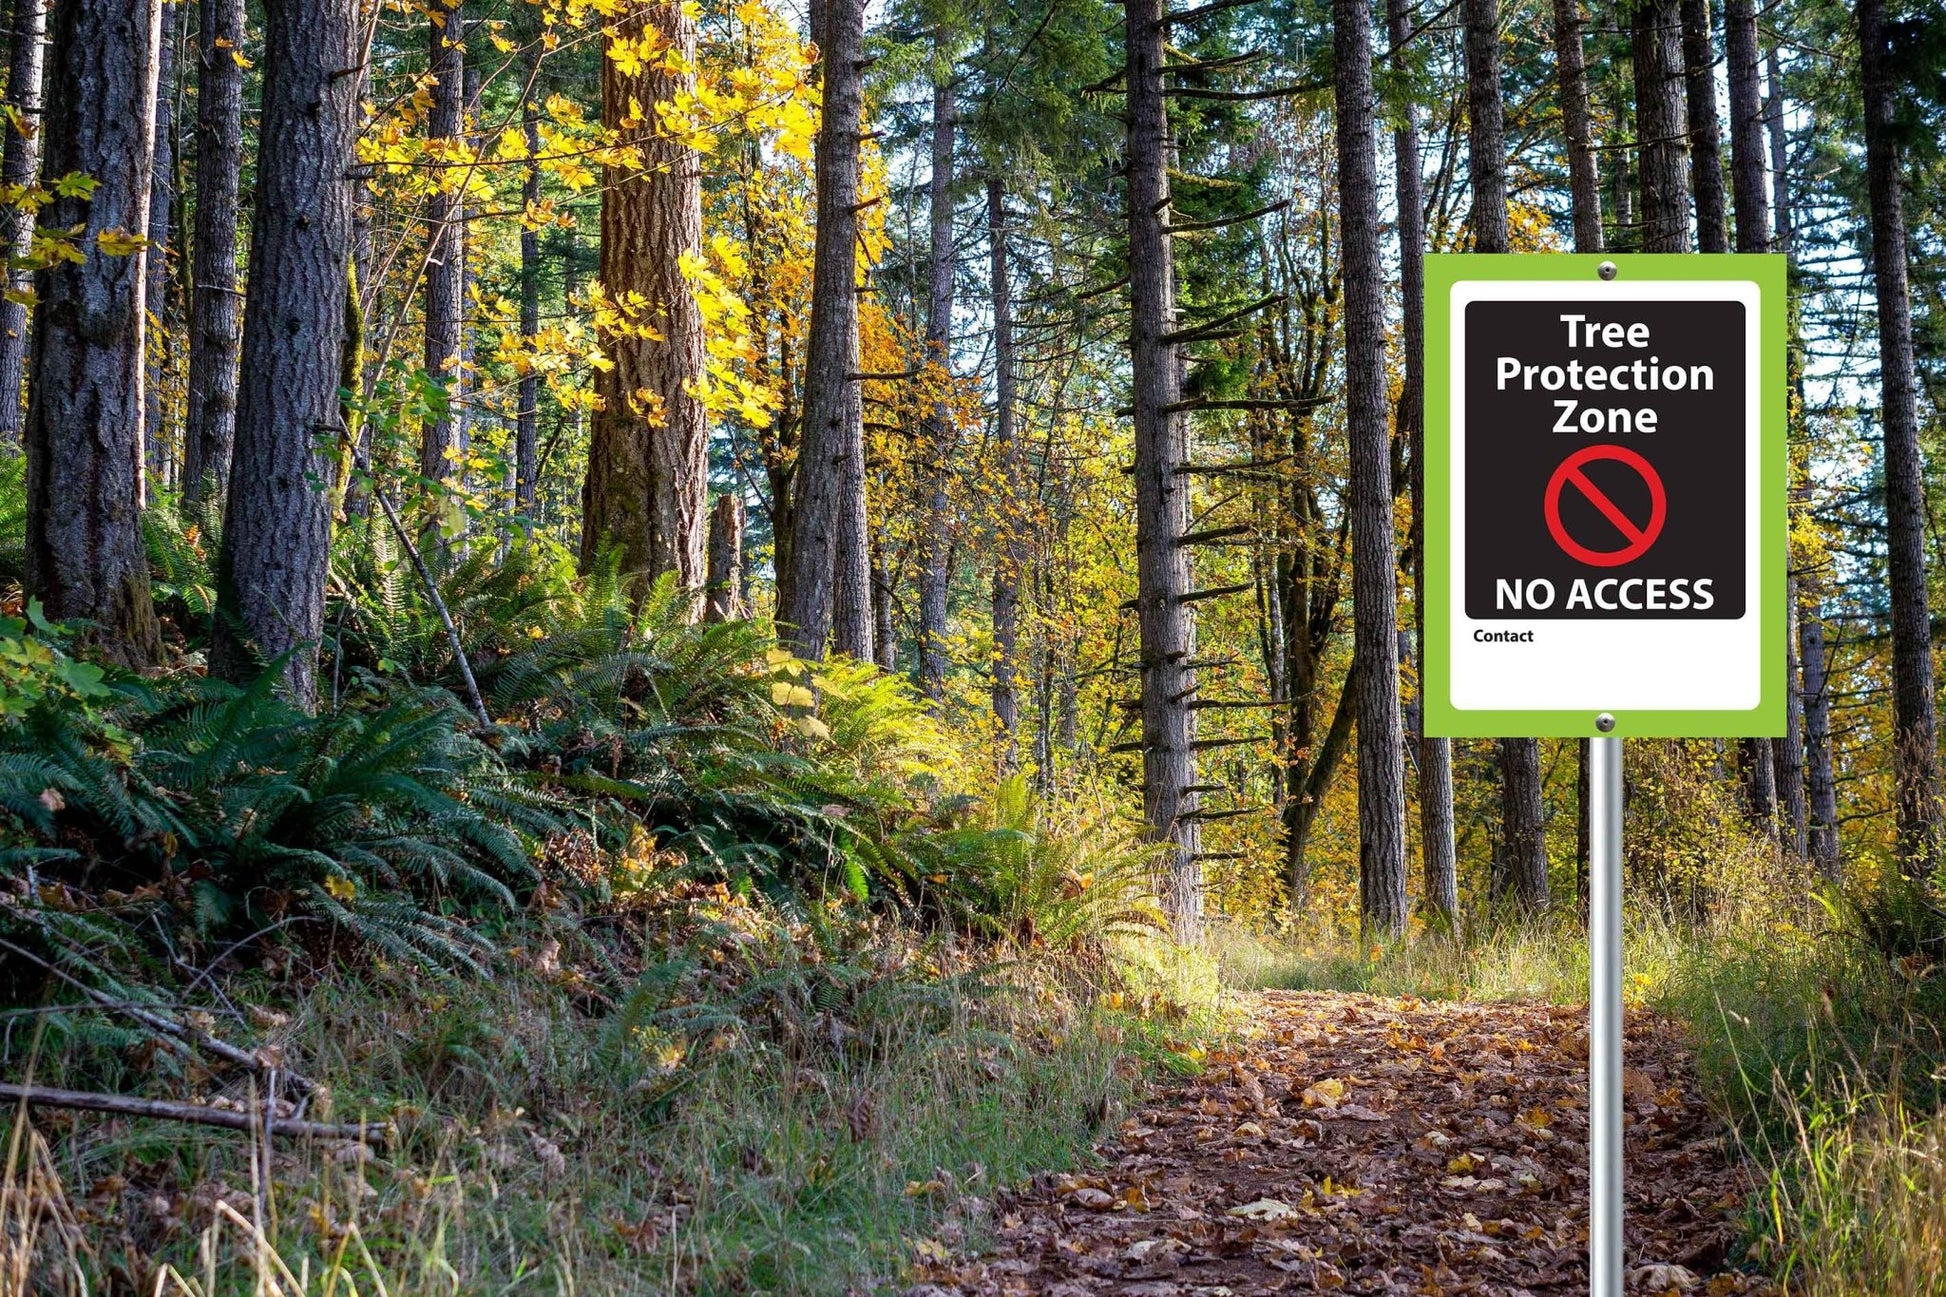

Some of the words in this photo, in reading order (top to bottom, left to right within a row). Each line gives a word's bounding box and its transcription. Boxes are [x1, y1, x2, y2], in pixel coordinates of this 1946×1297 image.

[1560, 314, 1650, 348] Tree
[1497, 356, 1714, 391] Protection
[1552, 399, 1658, 434] Zone
[1496, 578, 1556, 610] NO
[1566, 578, 1715, 610] ACCESS
[1473, 629, 1534, 643] Contact
